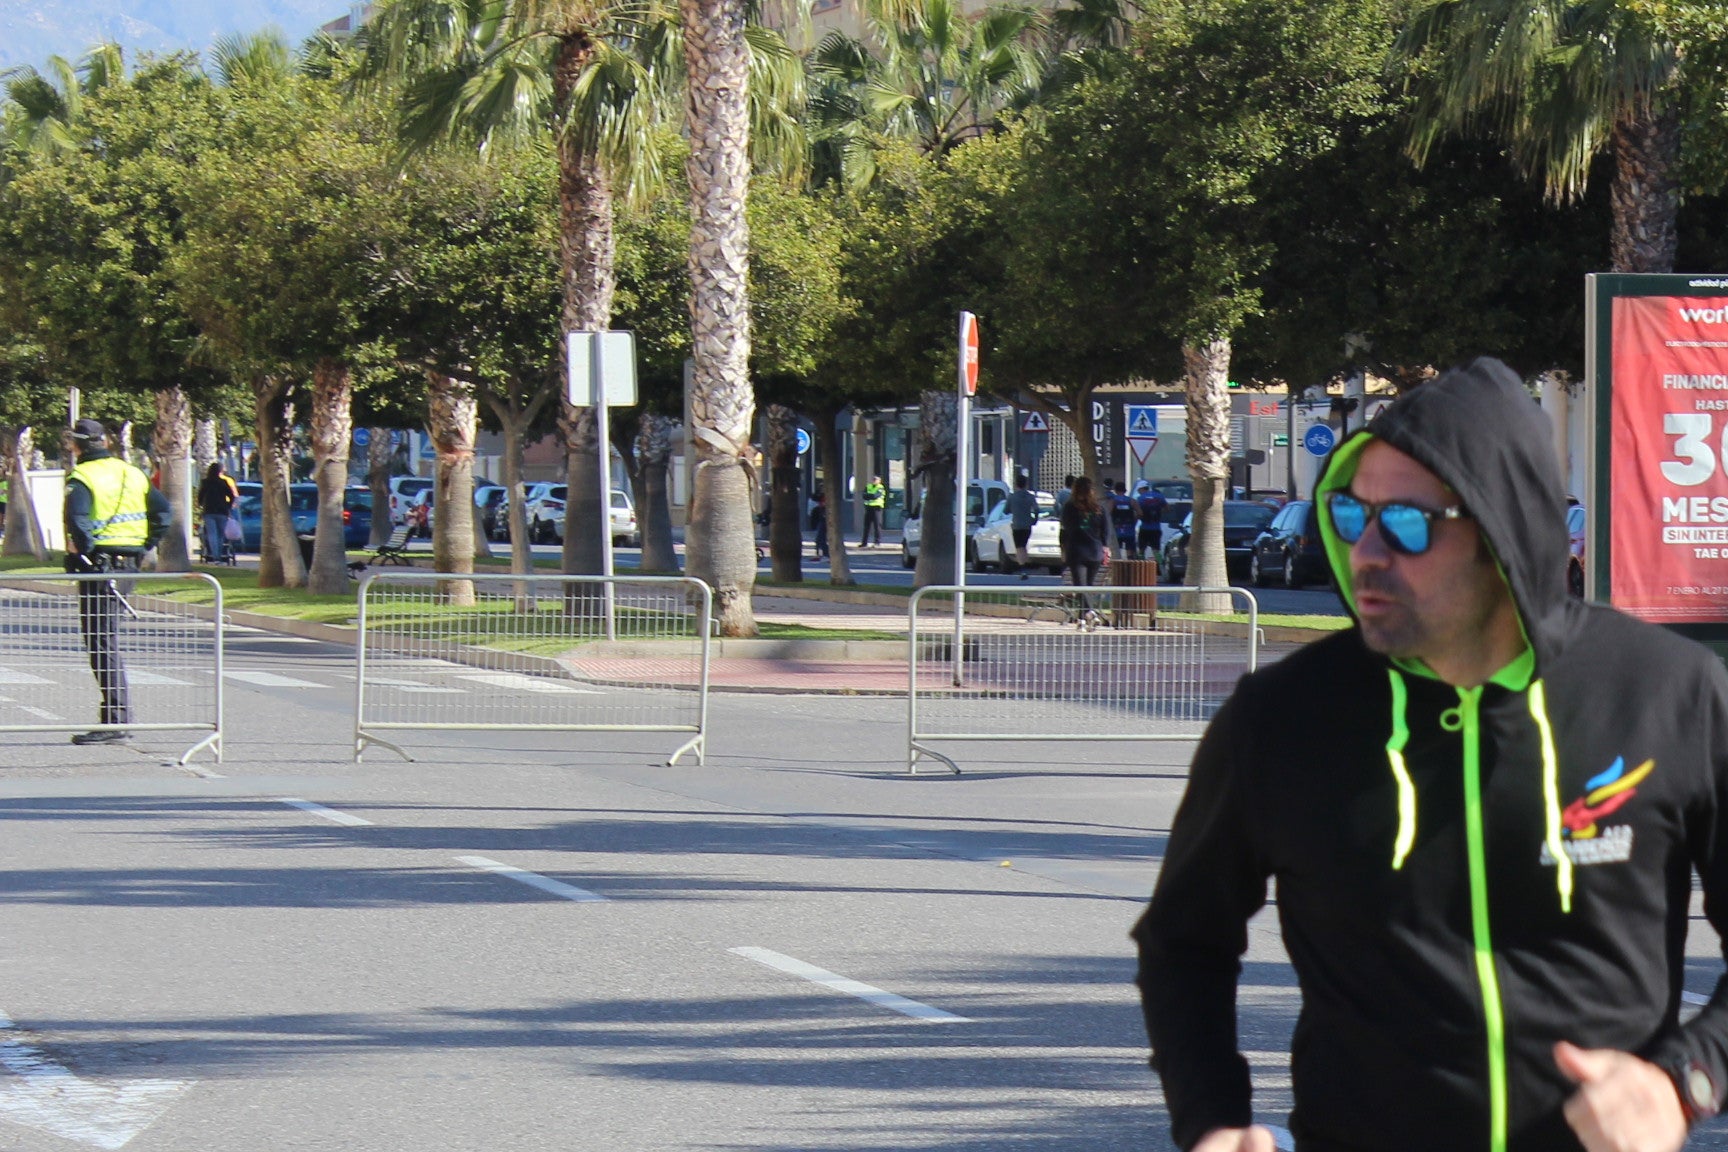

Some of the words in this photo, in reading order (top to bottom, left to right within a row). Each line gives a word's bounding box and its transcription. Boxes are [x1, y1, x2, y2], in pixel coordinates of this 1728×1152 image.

[1667, 529, 1691, 541] SIN
[1693, 548, 1719, 559] TAE
[1673, 586, 1700, 595] ENERO
